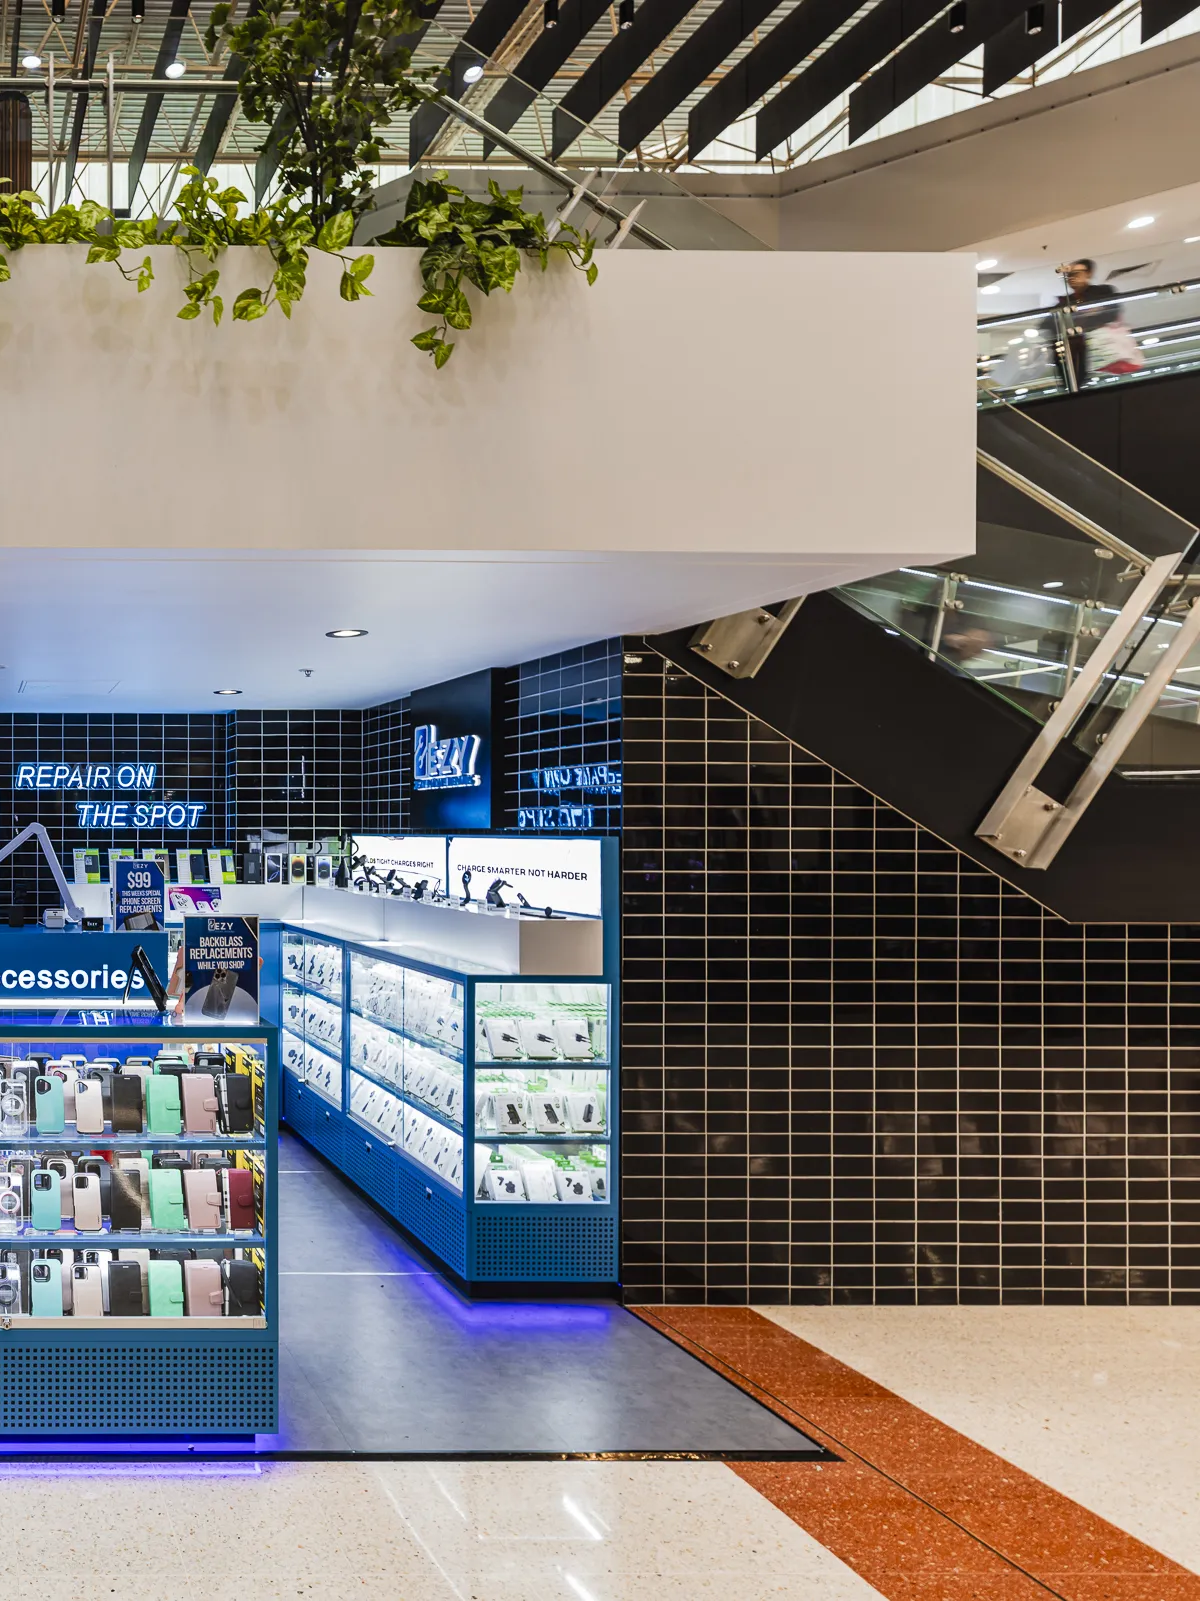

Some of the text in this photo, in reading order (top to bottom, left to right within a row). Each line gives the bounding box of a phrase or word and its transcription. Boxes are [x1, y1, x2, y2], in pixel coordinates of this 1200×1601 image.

[17, 765, 155, 788] REPAIR ON
[77, 804, 205, 827] THE SPOT
[390, 859, 416, 868] CHARGES
[457, 864, 588, 881] CHARGE SMARTER NOT HARDER
[127, 871, 151, 889] $99
[122, 897, 161, 905] IPHONE SCREEN
[120, 905, 162, 913] REPLACEMENTS
[199, 935, 244, 947] BACKGLASS
[189, 947, 253, 959] REPLACEMENTS
[197, 960, 245, 969] WHILE YOU SHOP
